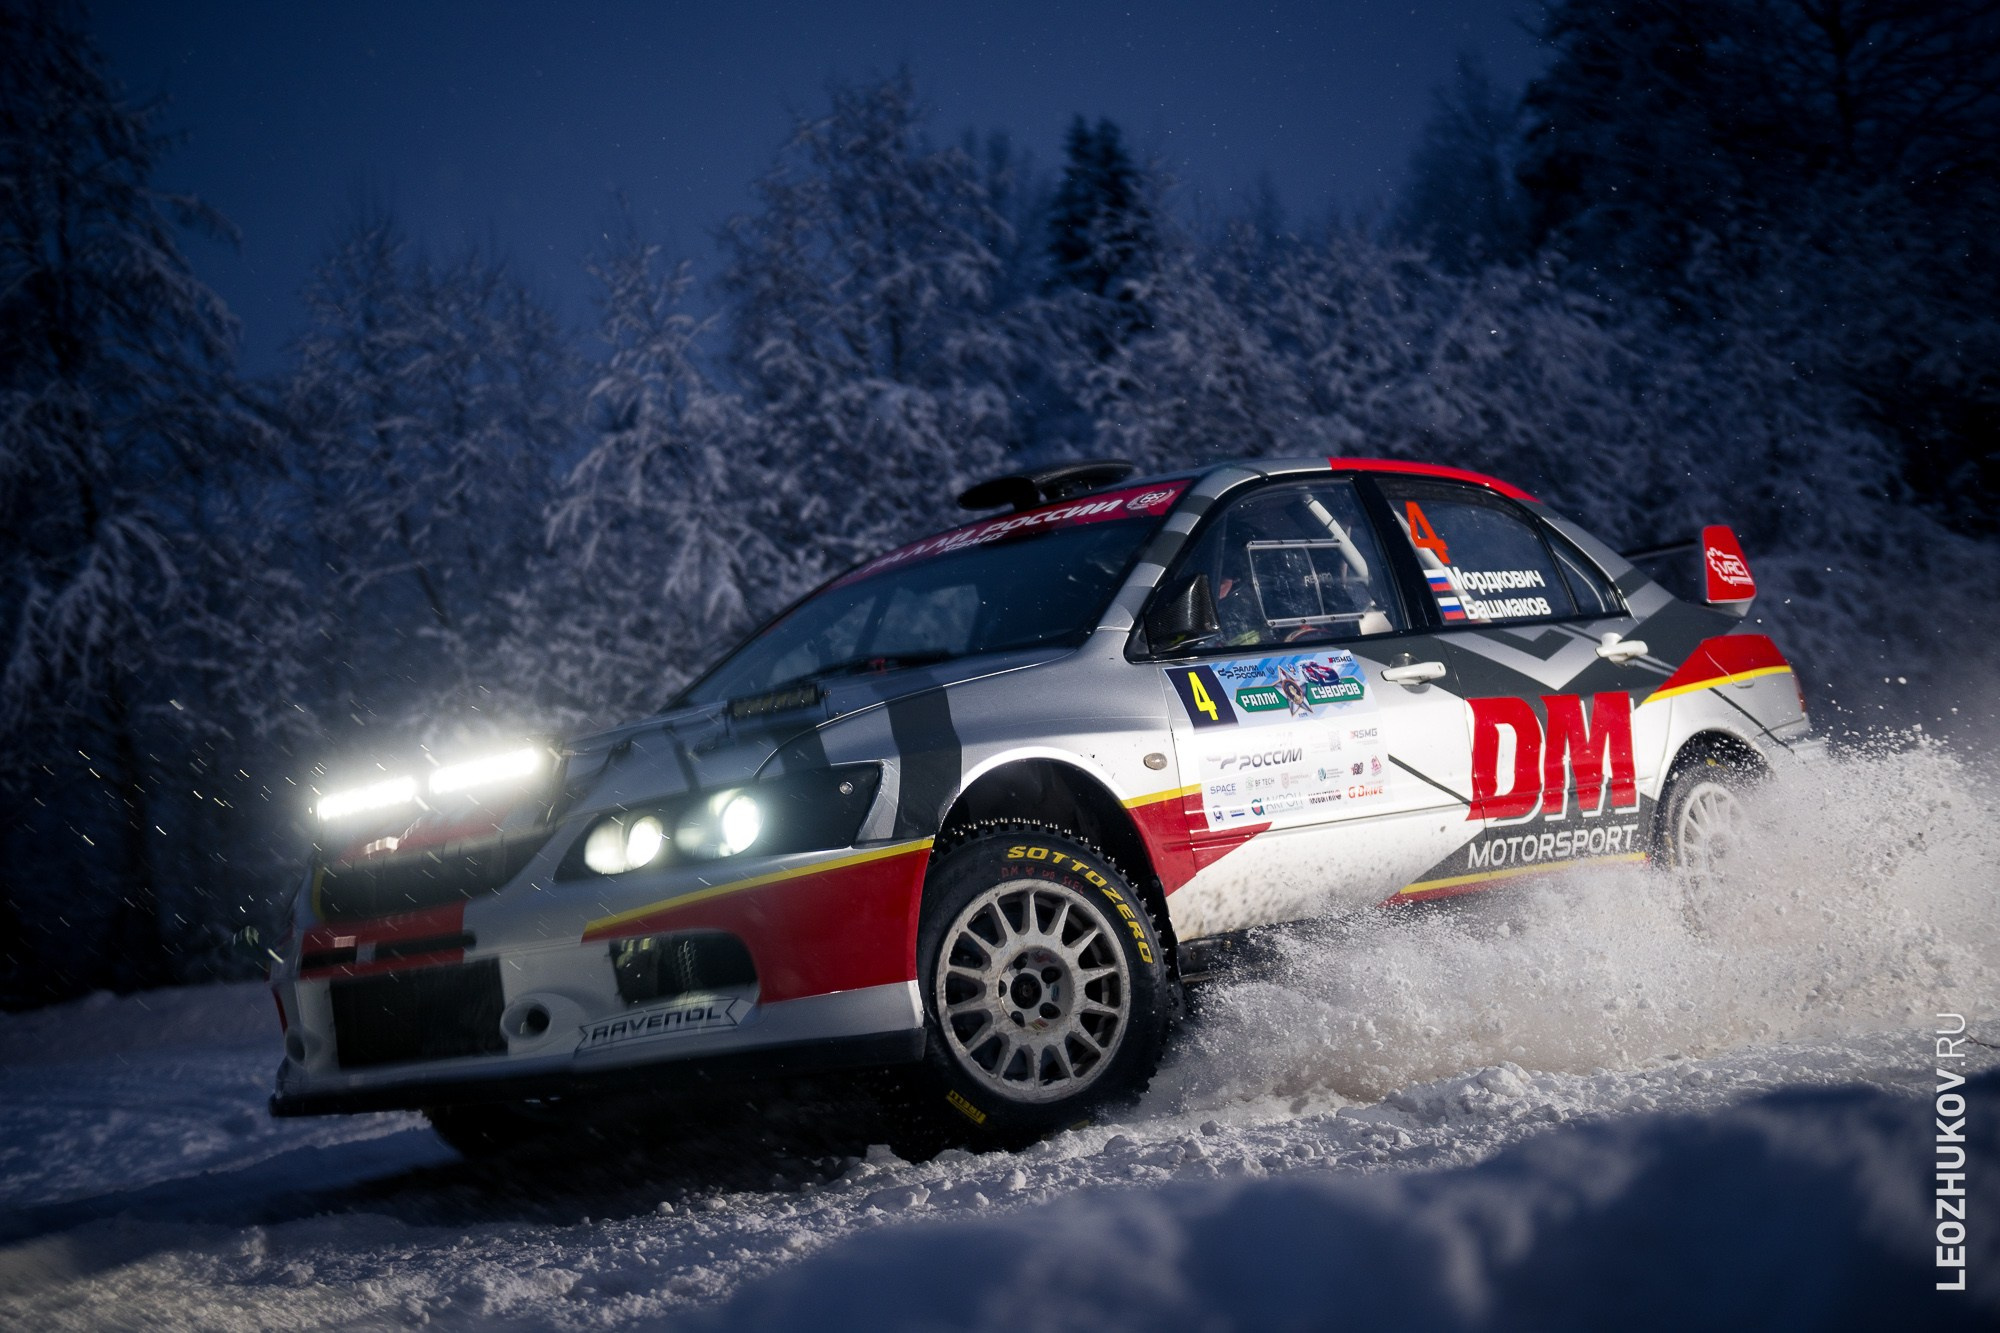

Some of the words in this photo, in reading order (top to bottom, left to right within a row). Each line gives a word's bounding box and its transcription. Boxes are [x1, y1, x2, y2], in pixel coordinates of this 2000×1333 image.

[979, 499, 1124, 537] РОССИИ
[1405, 500, 1451, 565] 4
[1445, 566, 1546, 595] Мордкович
[1459, 595, 1552, 620] Башмаков
[1236, 671, 1266, 680] РОССИИ
[1188, 671, 1219, 721] 4
[1240, 691, 1280, 708] РАЛЛИ
[1310, 682, 1361, 699] СУВОРОВ
[1239, 748, 1303, 770] РОССИИ
[1465, 690, 1640, 828] DM
[1210, 783, 1236, 795] SPACE
[1467, 824, 1639, 869] MOTORSPORT
[1007, 845, 1155, 964] SOTTOZERO
[591, 1006, 721, 1041] RAVENOL
